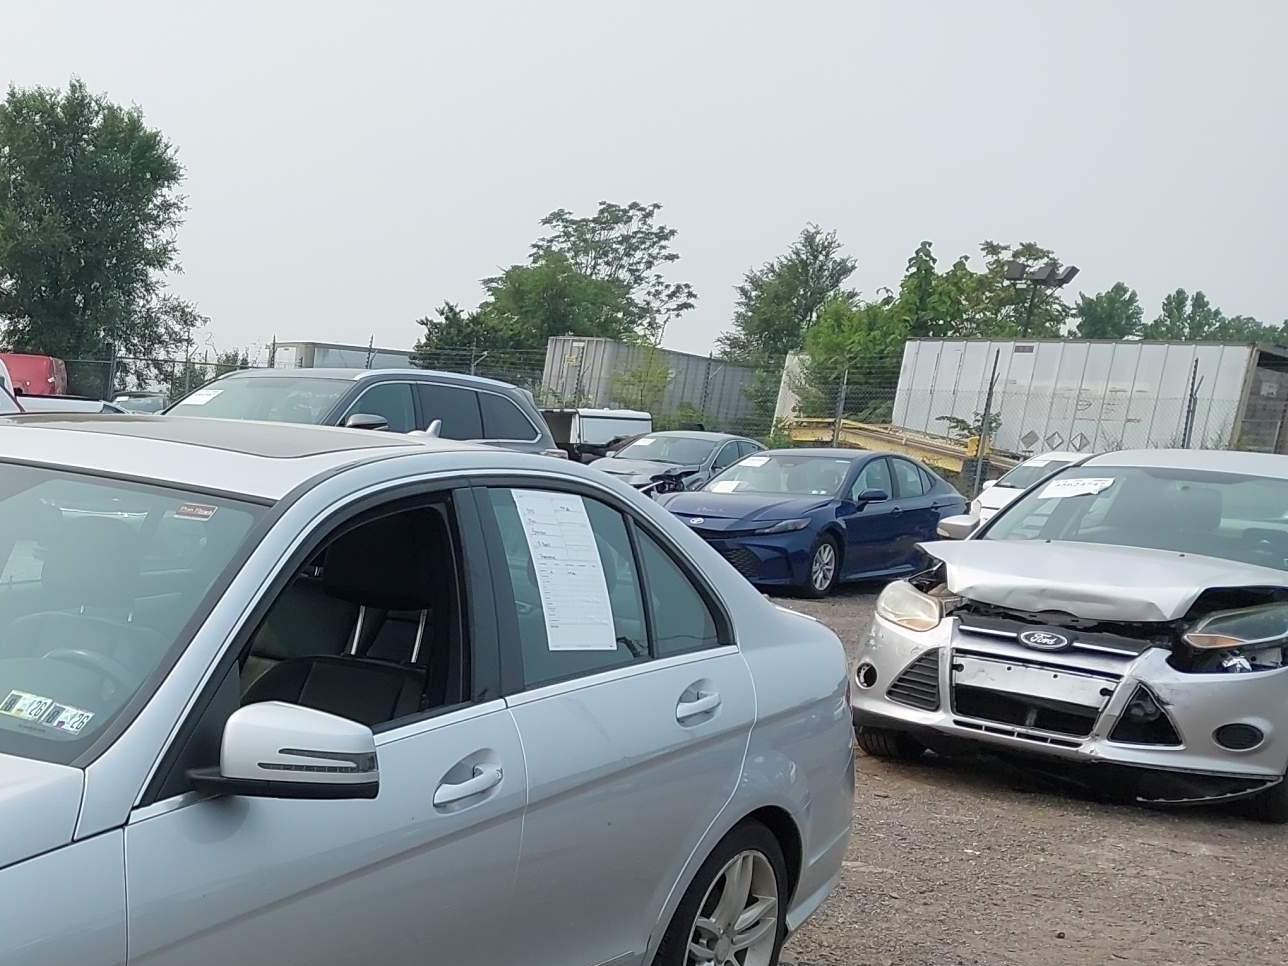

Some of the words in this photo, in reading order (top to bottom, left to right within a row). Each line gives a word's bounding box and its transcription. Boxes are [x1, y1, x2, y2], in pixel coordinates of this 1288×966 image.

[1030, 633, 1058, 645] Ford
[28, 700, 48, 718] 26
[70, 713, 89, 730] 26
